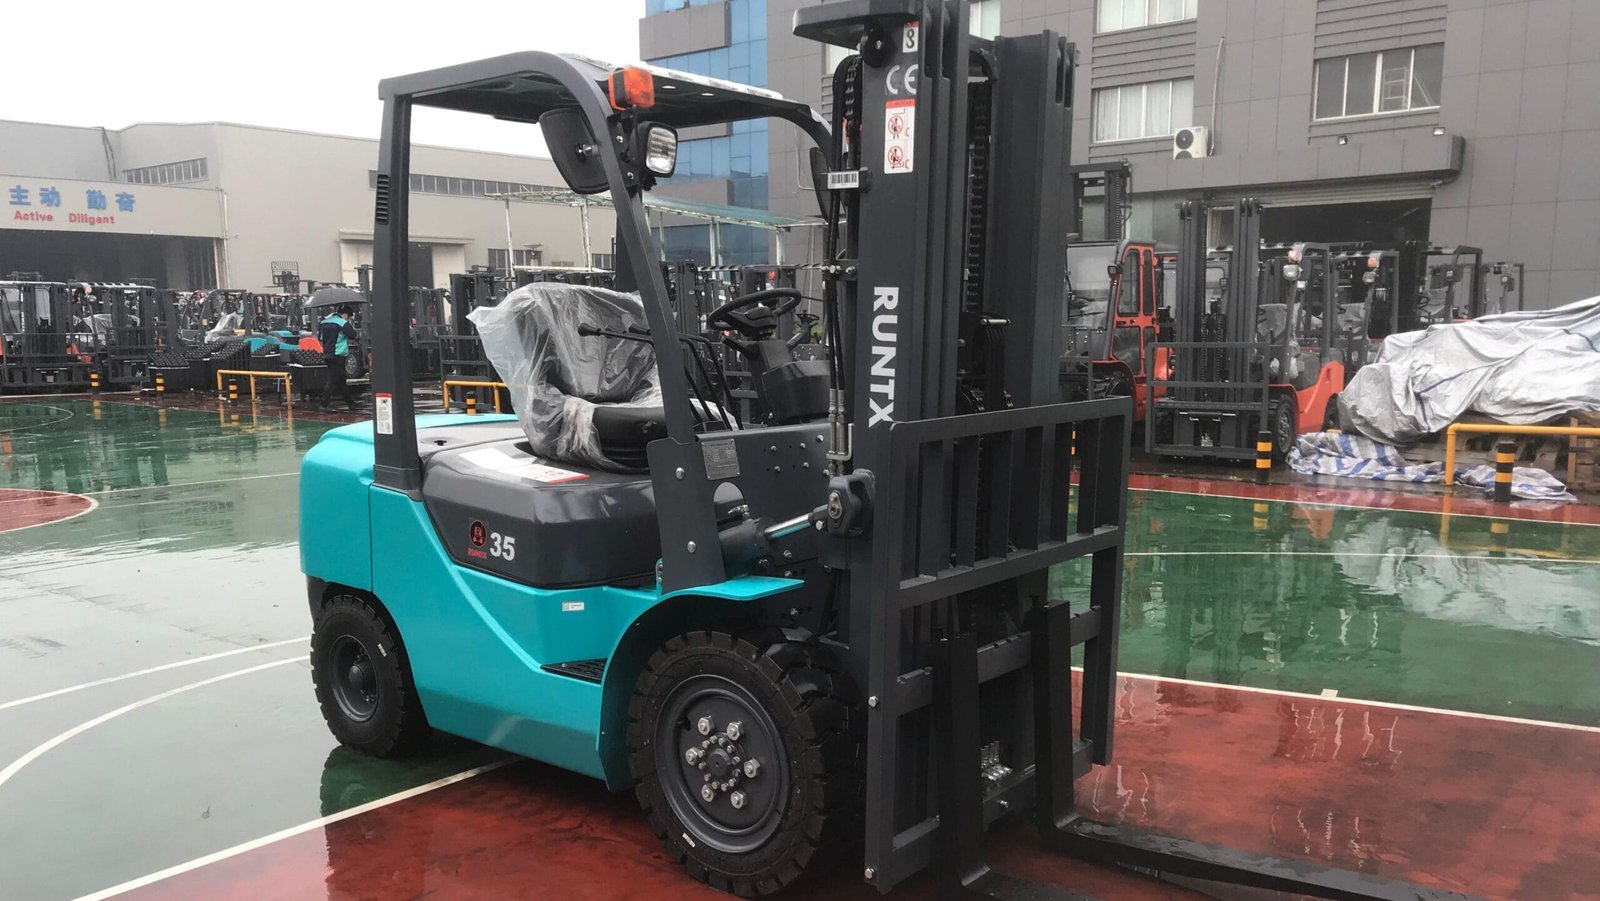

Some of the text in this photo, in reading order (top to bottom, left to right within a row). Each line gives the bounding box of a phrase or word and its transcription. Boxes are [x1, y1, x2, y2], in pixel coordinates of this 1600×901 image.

[886, 64, 918, 95] CE
[9, 185, 61, 207] 主动
[14, 210, 115, 225] Active Diligent
[868, 286, 899, 428] RUNTX
[489, 531, 515, 561] 35
